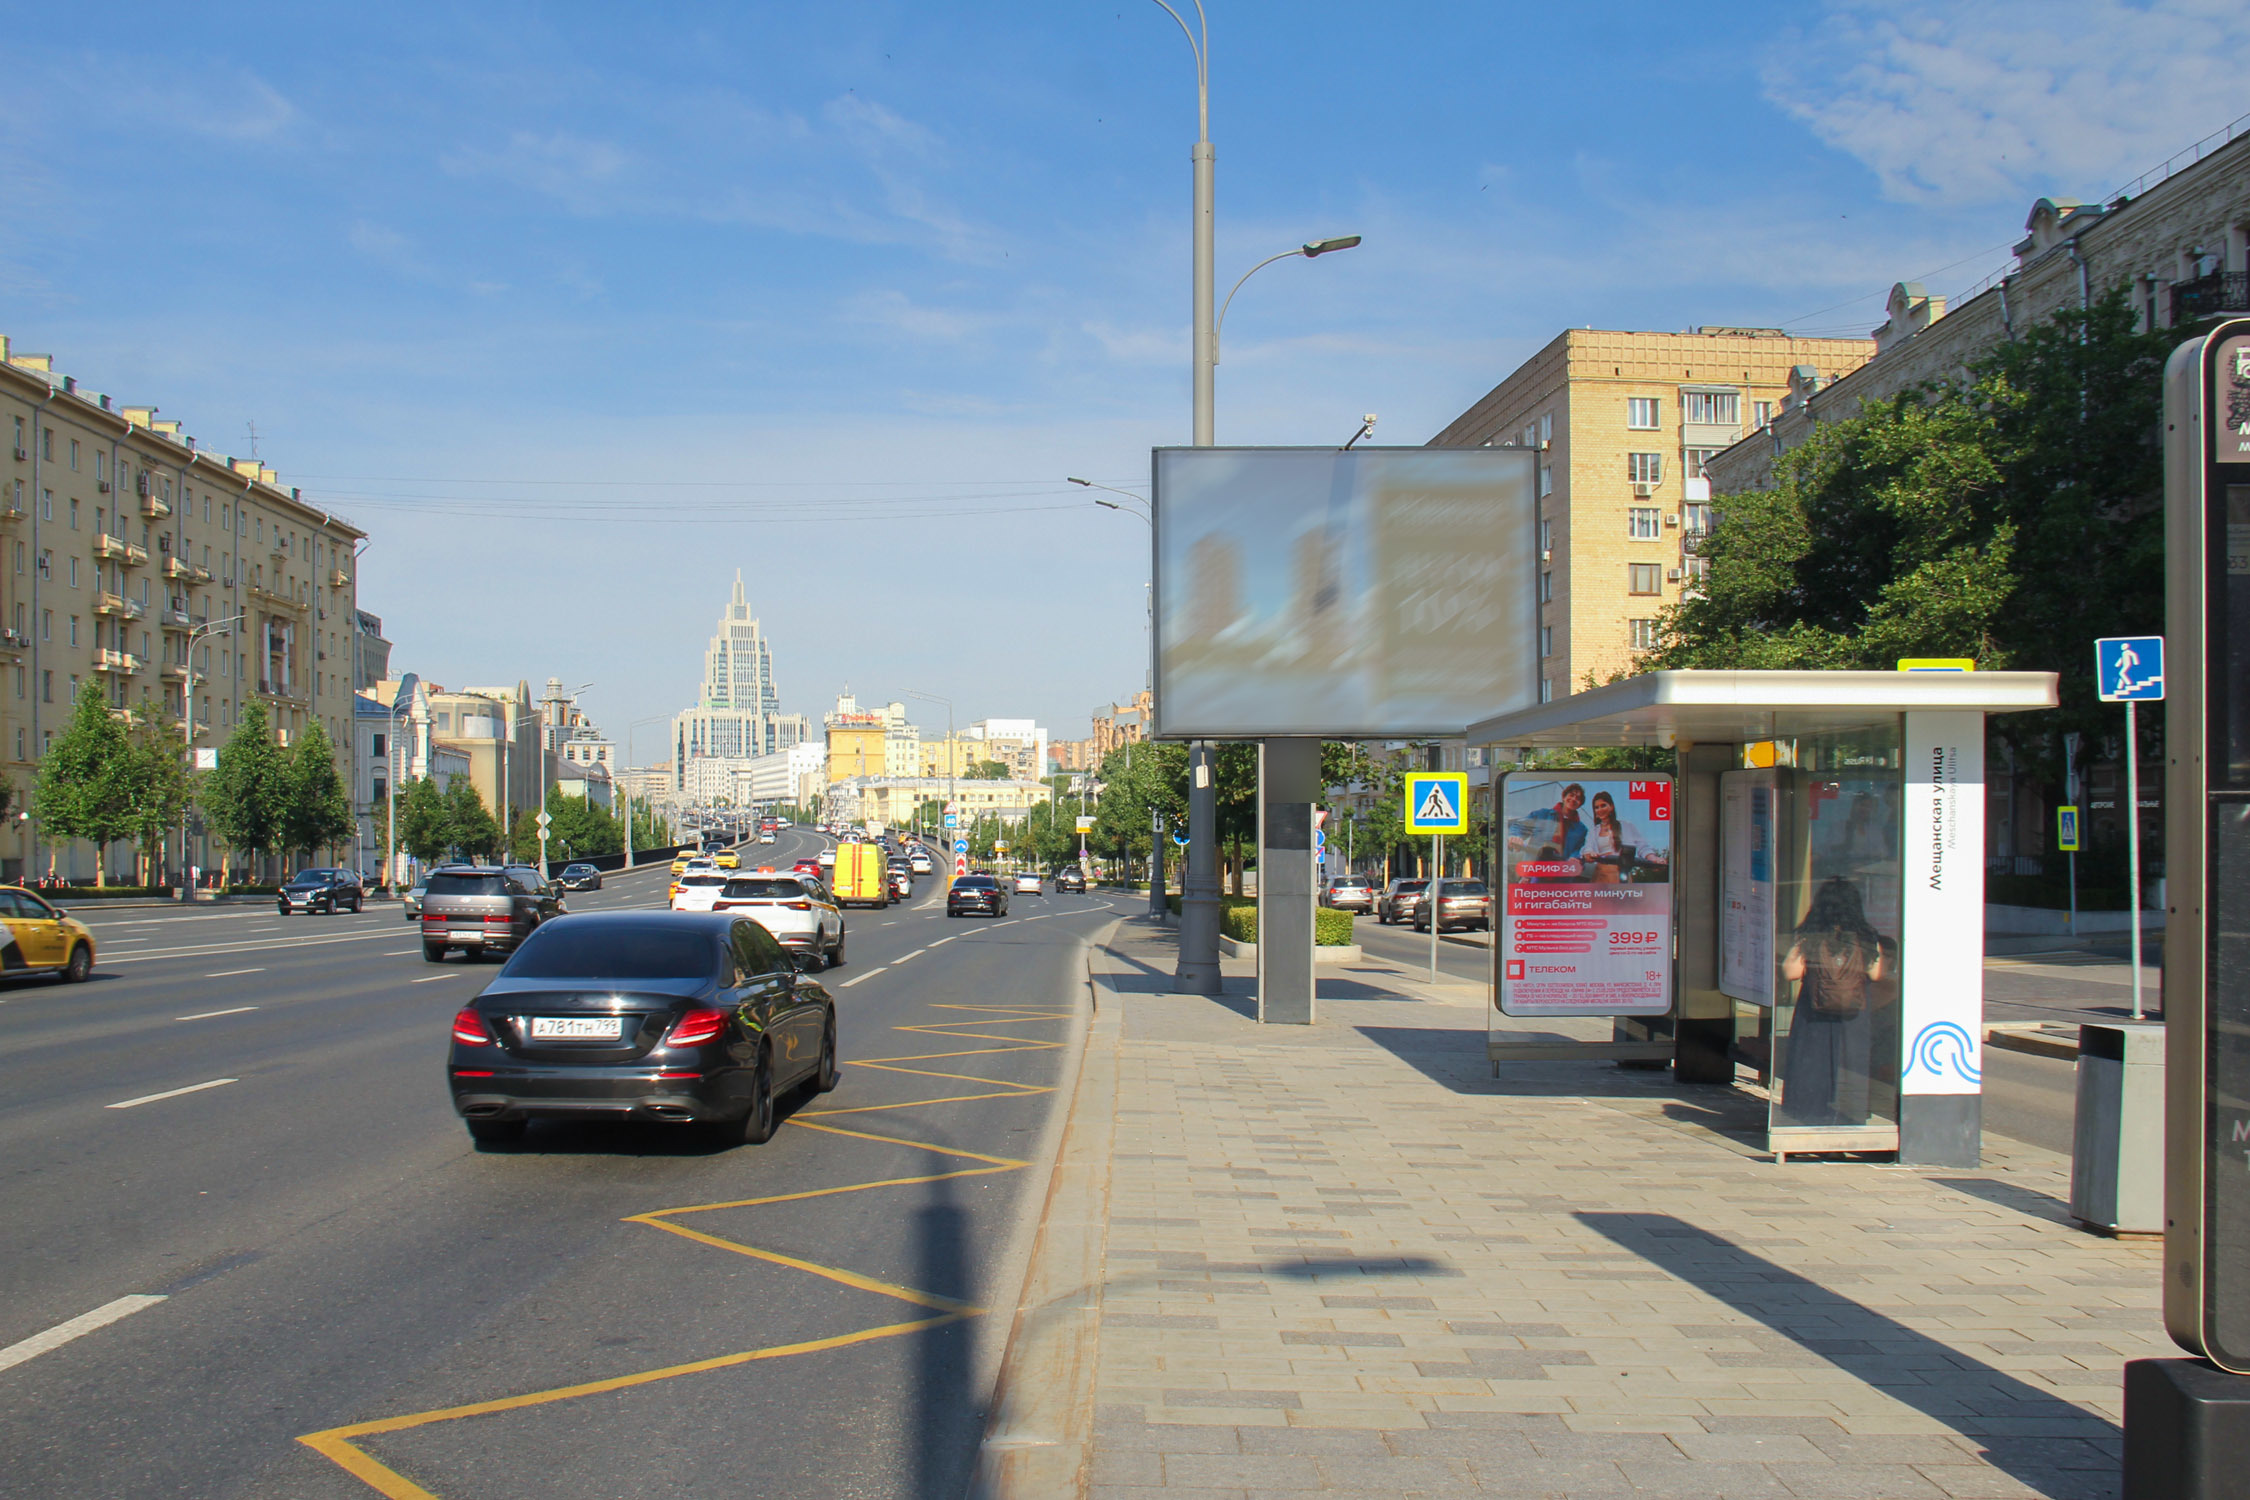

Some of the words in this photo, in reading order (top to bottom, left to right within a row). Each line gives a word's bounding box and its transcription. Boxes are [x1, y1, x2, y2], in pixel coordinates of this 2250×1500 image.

[1932, 746, 1945, 793] улица
[1929, 798, 1944, 890] Мещанская
[1521, 864, 1560, 873] ТАРИФ
[1562, 864, 1576, 873] 24
[1514, 888, 1592, 900] Переносите
[1594, 889, 1643, 900] минуты
[1514, 901, 1521, 909] и
[1524, 899, 1592, 909] гигабайты
[1645, 971, 1662, 981] 18+
